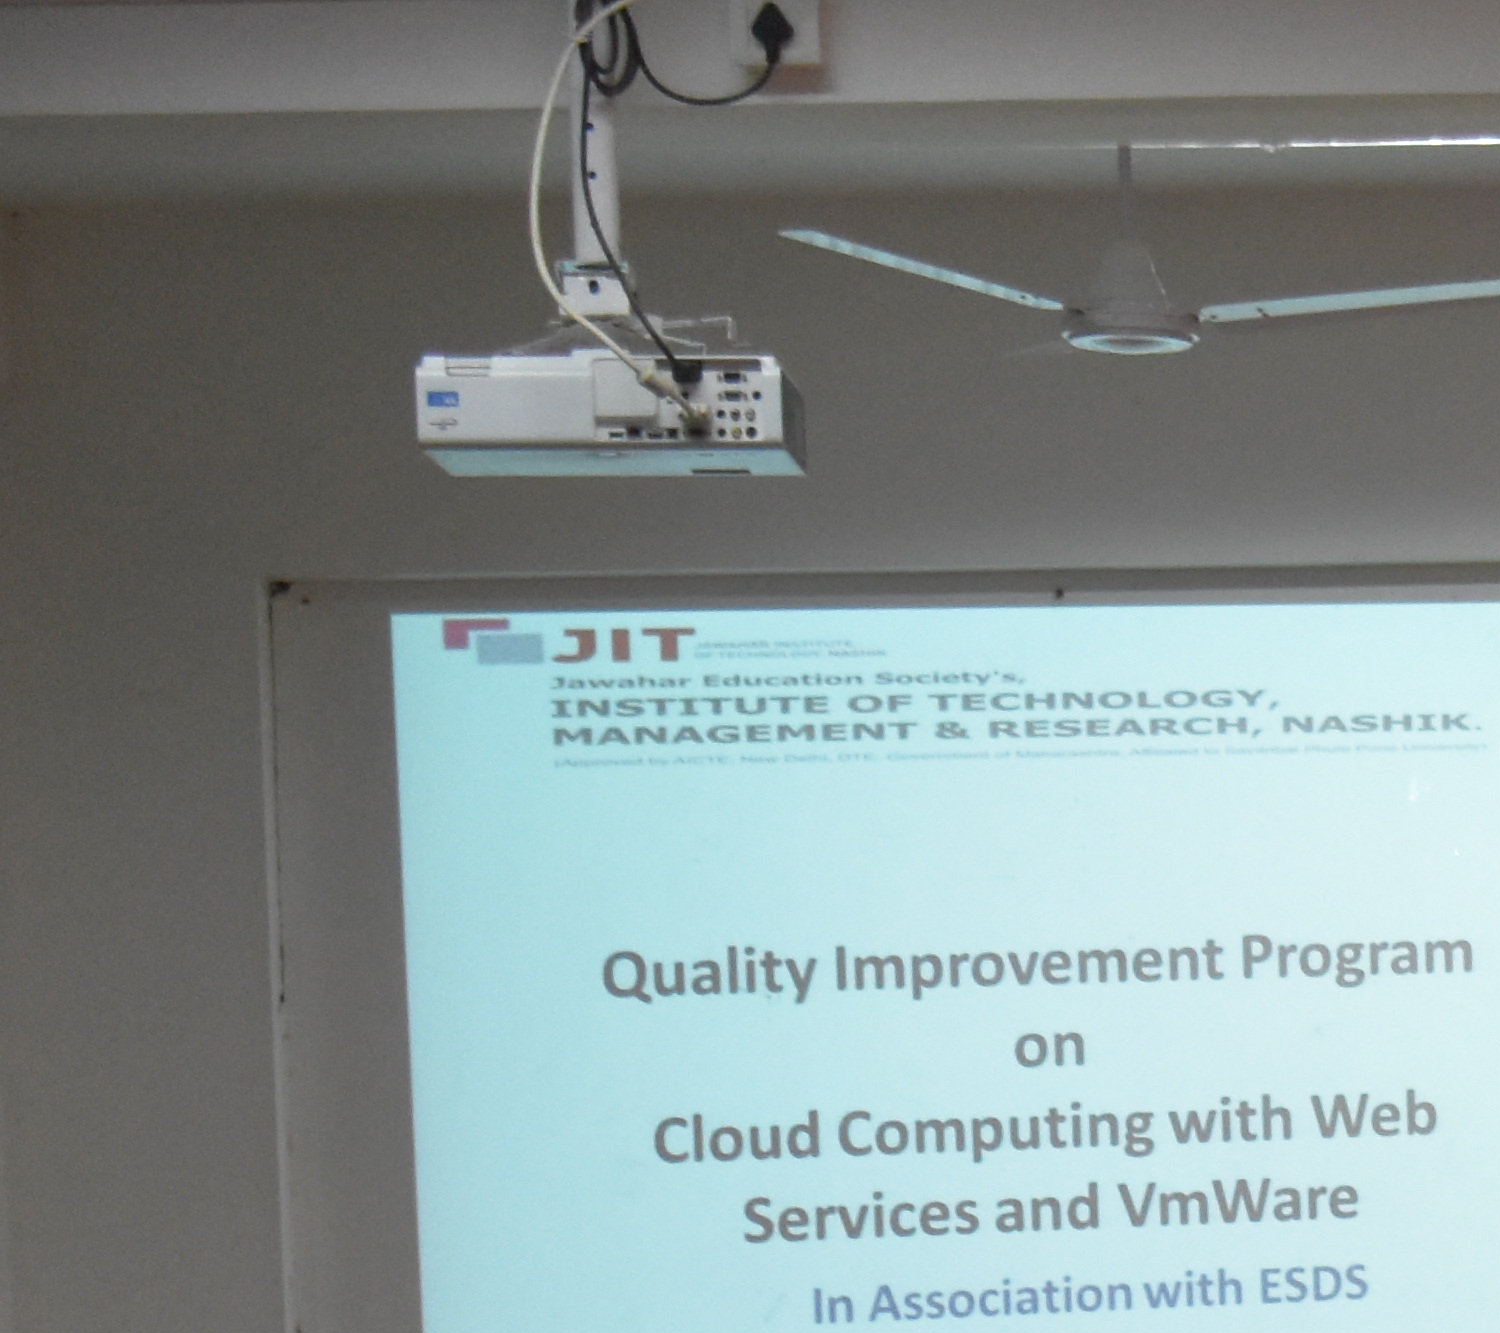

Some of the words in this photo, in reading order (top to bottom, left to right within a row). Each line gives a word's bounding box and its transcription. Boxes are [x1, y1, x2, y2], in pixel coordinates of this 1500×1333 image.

[552, 627, 696, 663] JIT
[550, 675, 692, 690] Jawahar
[702, 673, 863, 688] Education
[550, 694, 829, 719] INSTITUTE
[848, 694, 915, 716] OF
[929, 687, 1280, 714] TECHNOLOGY,
[551, 720, 919, 747] MANAGEMENT
[934, 720, 972, 740] &
[988, 716, 1264, 741] RESEARCH,
[1281, 711, 1484, 735] NASHIK.
[601, 944, 818, 1004] Quality
[836, 934, 1224, 1000] Improvement
[1242, 929, 1474, 988] Program
[1015, 1028, 1086, 1069] on
[654, 1108, 820, 1166] Cloud
[838, 1099, 1155, 1168] Computing
[1170, 1096, 1296, 1148] with
[1312, 1088, 1438, 1140] Web
[742, 1190, 981, 1245] Services
[995, 1182, 1101, 1235] and
[1117, 1176, 1359, 1231] VmWare
[813, 1286, 854, 1326] In
[869, 1271, 1133, 1323] Association
[1144, 1266, 1243, 1311] with
[1259, 1262, 1369, 1305] ESDS
